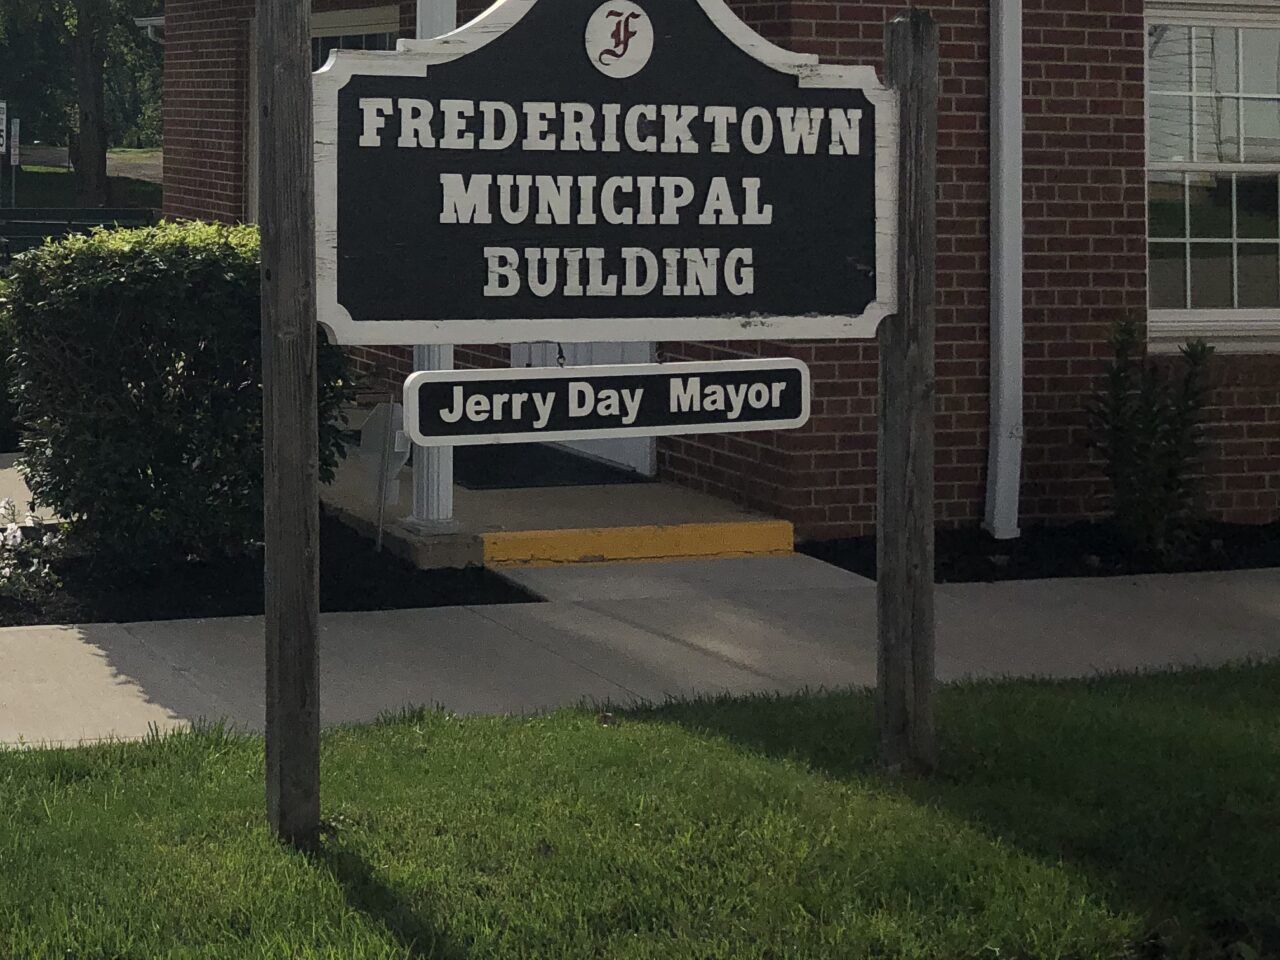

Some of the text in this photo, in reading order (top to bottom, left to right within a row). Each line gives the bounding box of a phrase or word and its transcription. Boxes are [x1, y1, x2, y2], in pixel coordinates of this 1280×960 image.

[359, 97, 863, 156] FREDERICKTOWN
[439, 173, 773, 225] MUNICIPAL
[483, 246, 754, 297] BUILDING
[439, 377, 787, 429] Jerry Day Mayor
